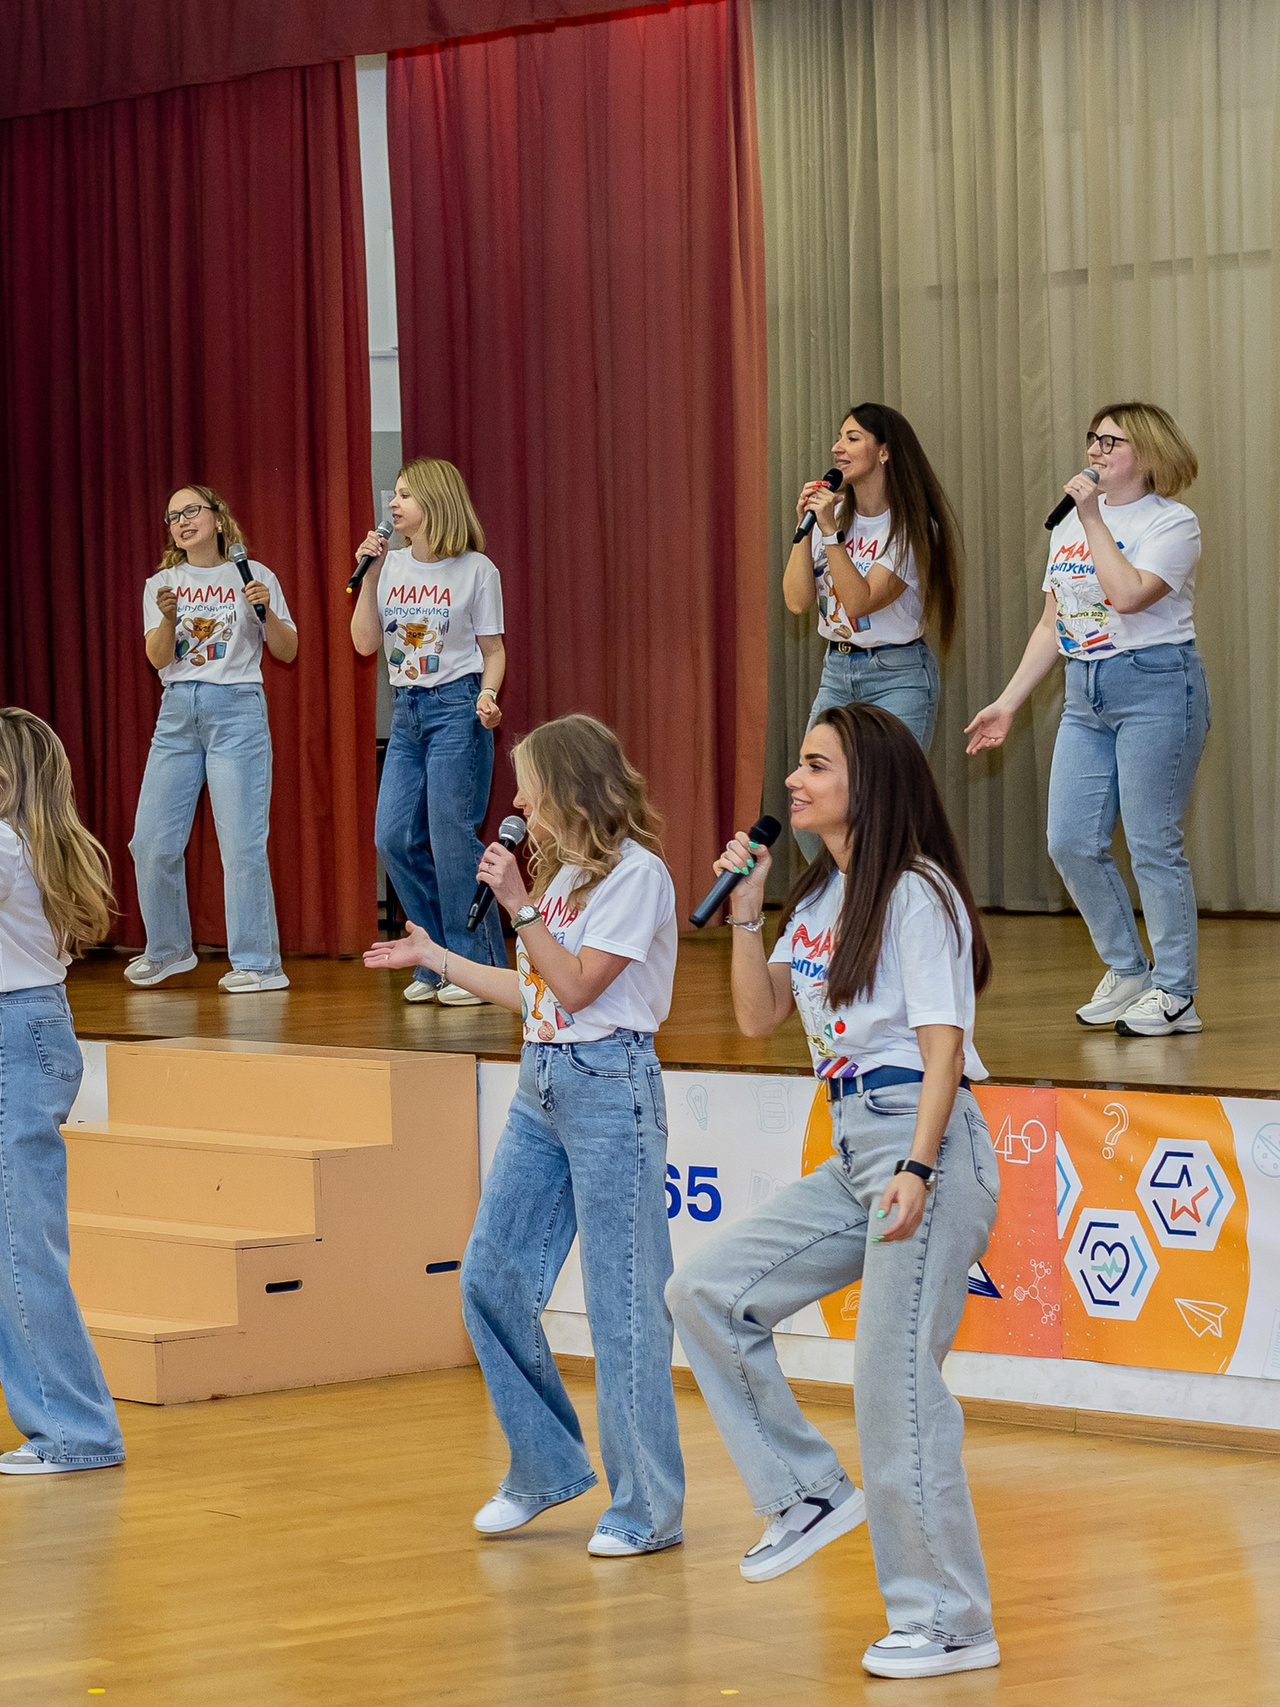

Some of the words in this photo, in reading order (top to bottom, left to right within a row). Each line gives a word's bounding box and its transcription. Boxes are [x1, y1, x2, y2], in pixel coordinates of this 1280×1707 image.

[845, 536, 878, 561] АМА
[1053, 541, 1091, 563] МА
[176, 585, 236, 603] МАМА
[386, 585, 451, 607] МАМА
[177, 603, 235, 613] ыпускника
[384, 606, 450, 618] выпускника
[537, 894, 579, 928] АМА
[792, 923, 838, 960] МА
